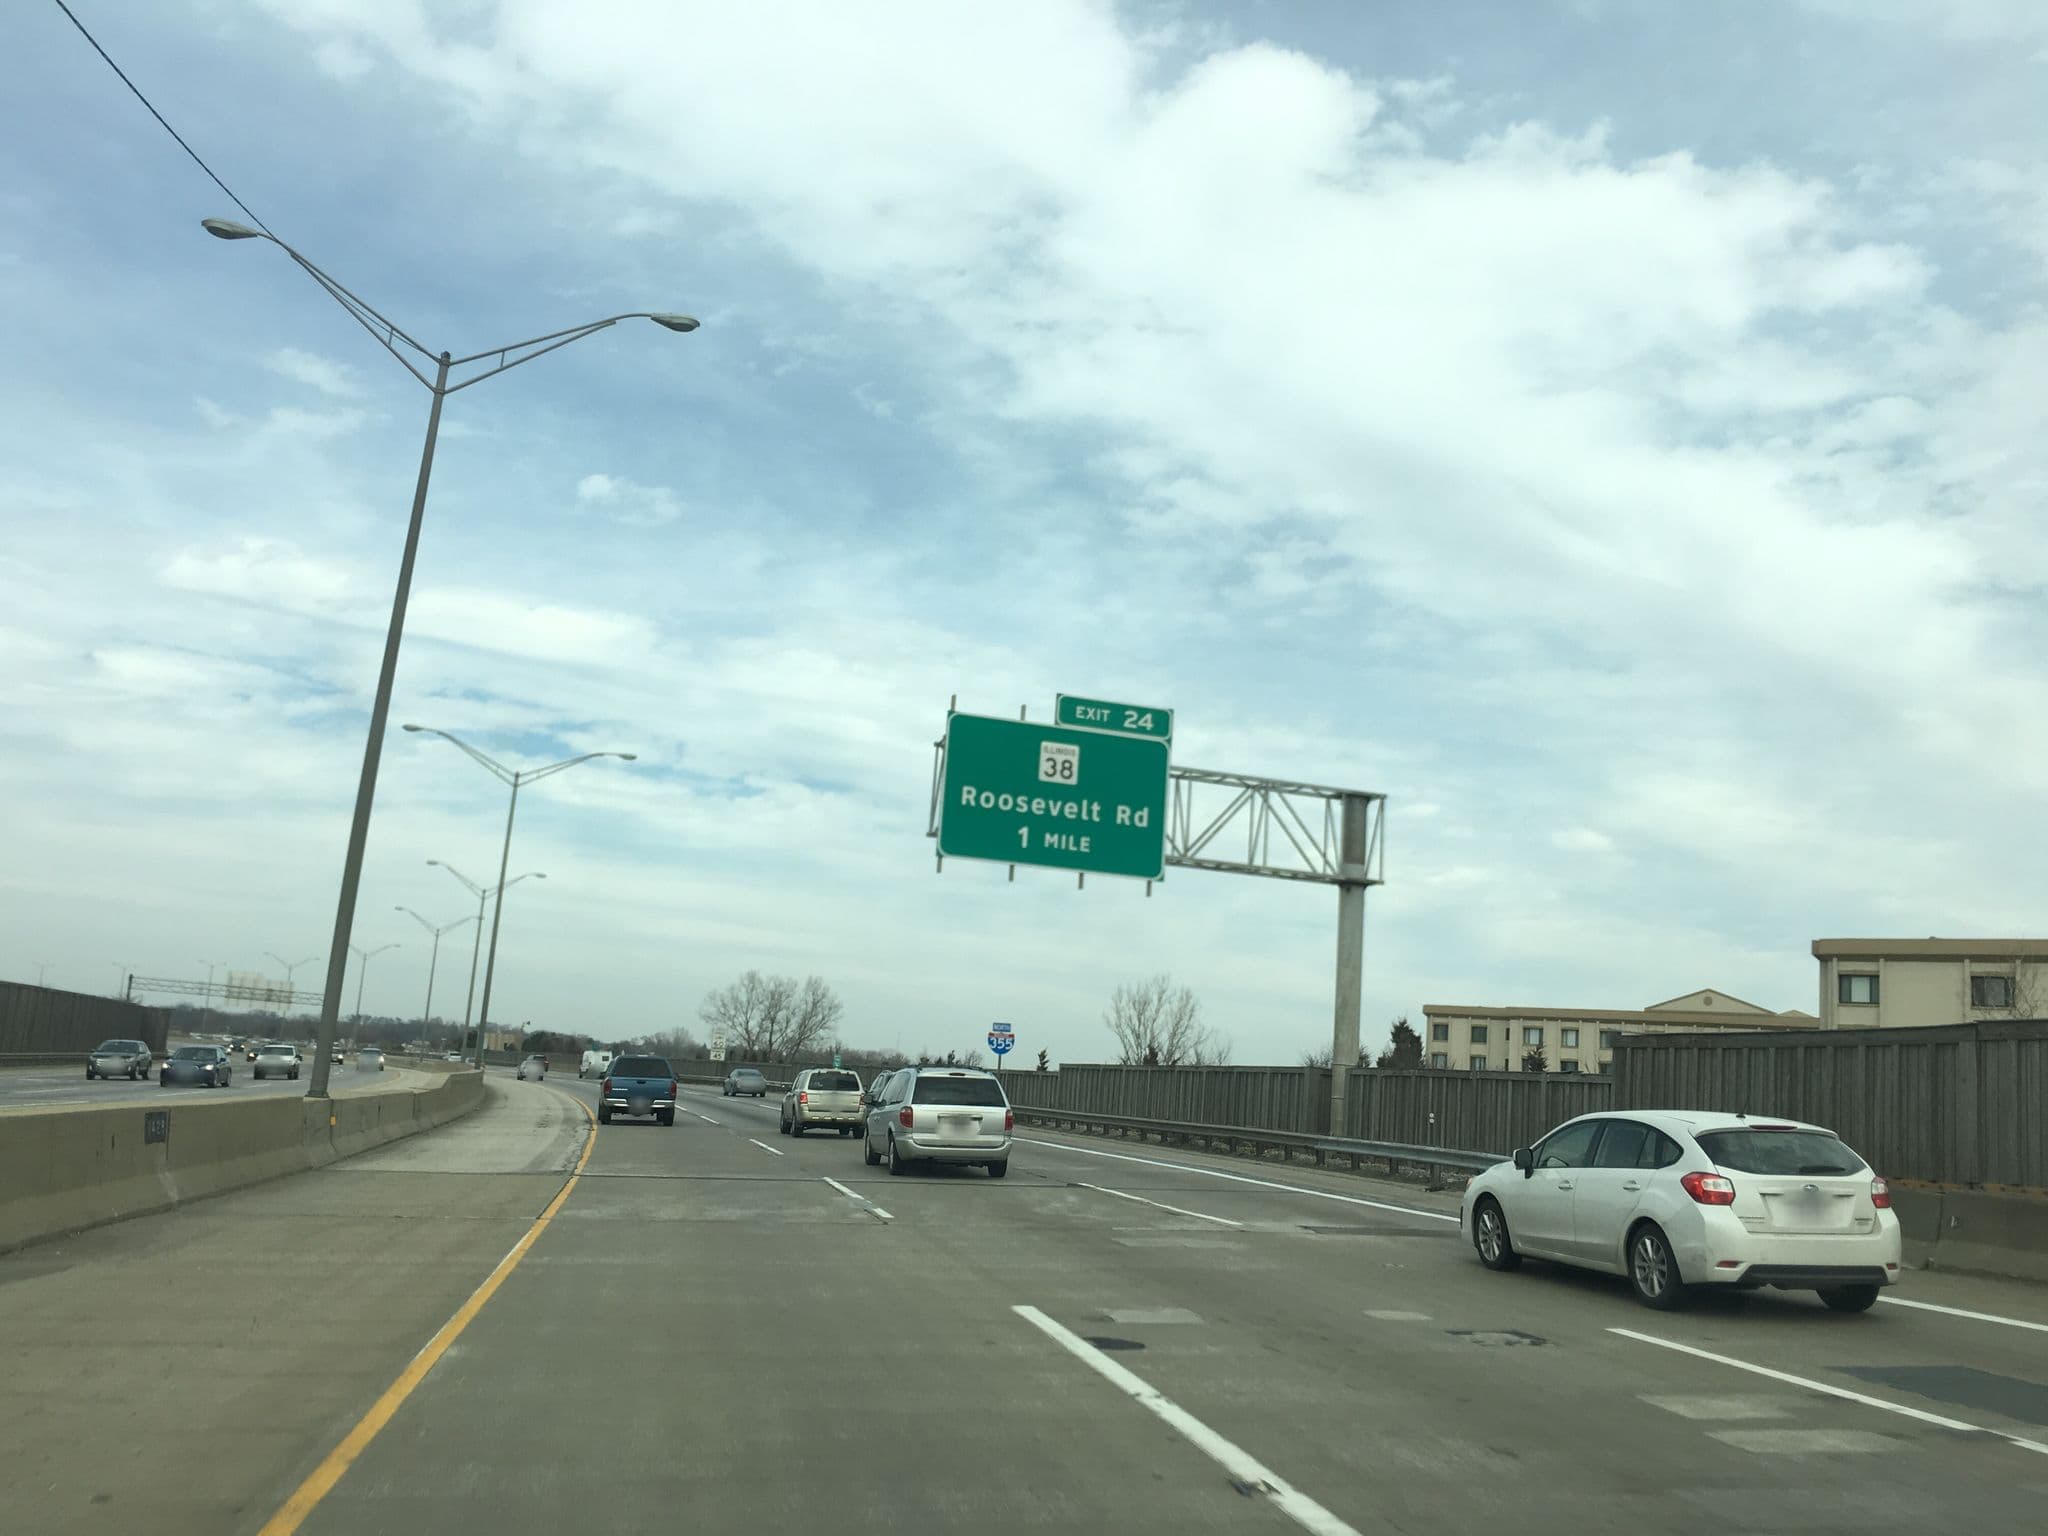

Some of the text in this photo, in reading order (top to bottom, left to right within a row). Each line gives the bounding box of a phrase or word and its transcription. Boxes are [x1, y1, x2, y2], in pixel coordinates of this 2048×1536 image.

[1075, 705, 1154, 730] EXIT 24
[1044, 757, 1073, 780] 38
[961, 785, 1149, 827] Roosevelt Rd
[1017, 826, 1091, 853] 1 MILE
[990, 1038, 1012, 1050] 355
